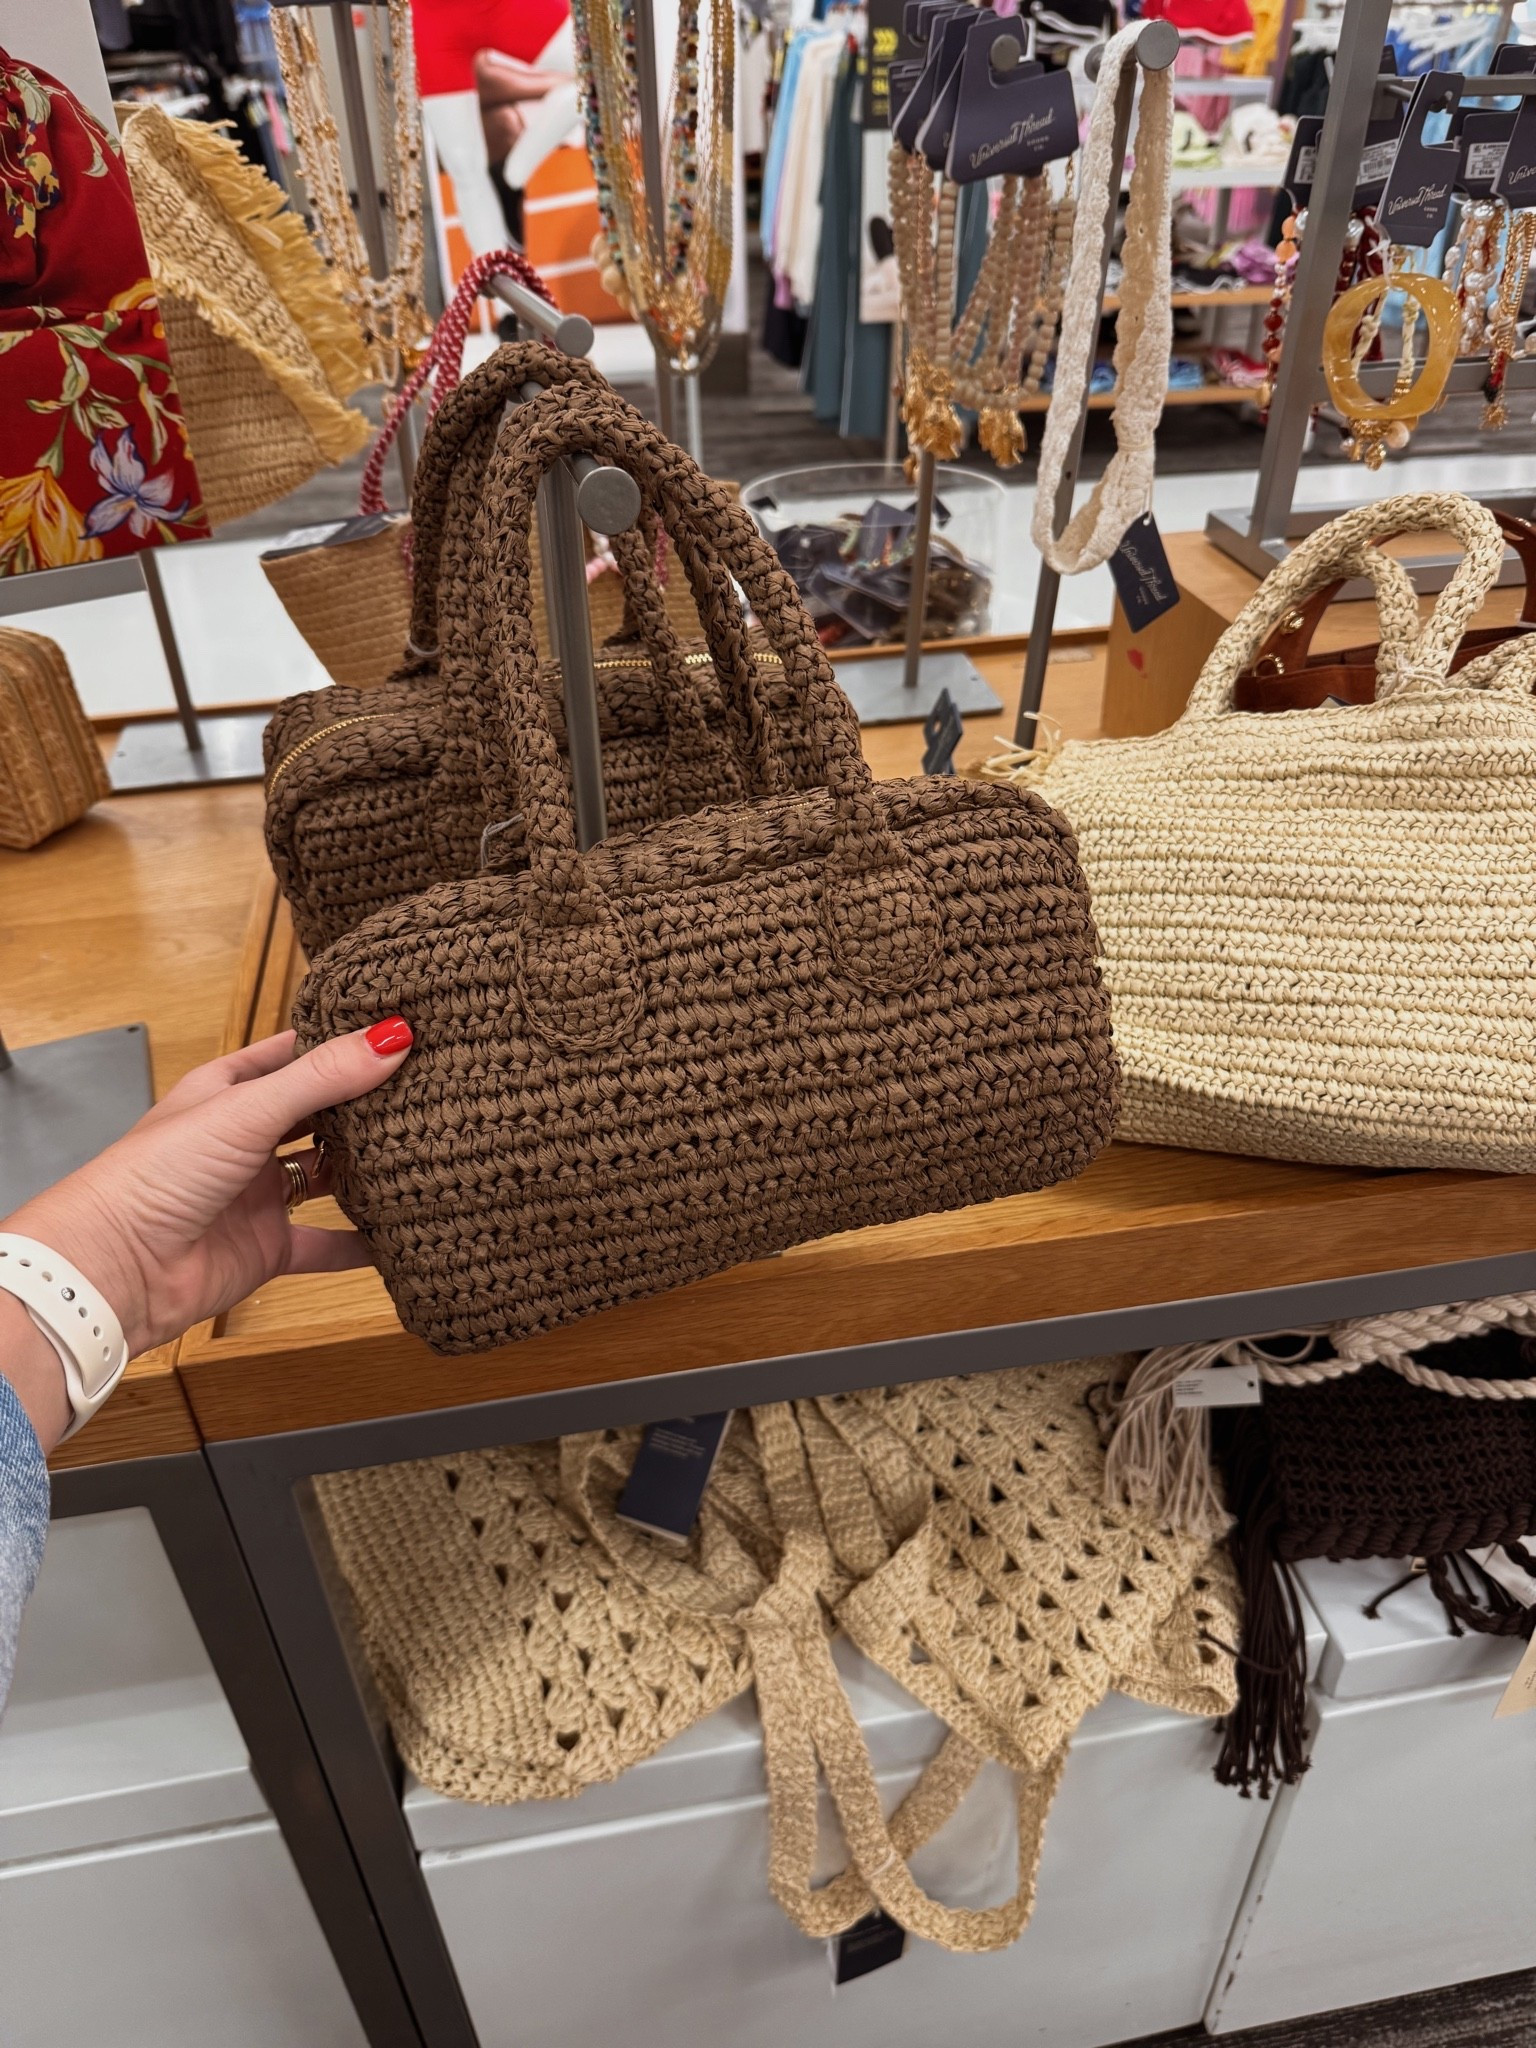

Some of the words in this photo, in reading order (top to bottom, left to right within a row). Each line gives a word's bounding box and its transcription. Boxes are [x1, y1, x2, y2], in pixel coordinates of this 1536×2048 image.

[969, 126, 1019, 169] Universal
[1010, 107, 1055, 145] Thread
[1388, 189, 1424, 215] Universal
[1418, 183, 1447, 207] Thread
